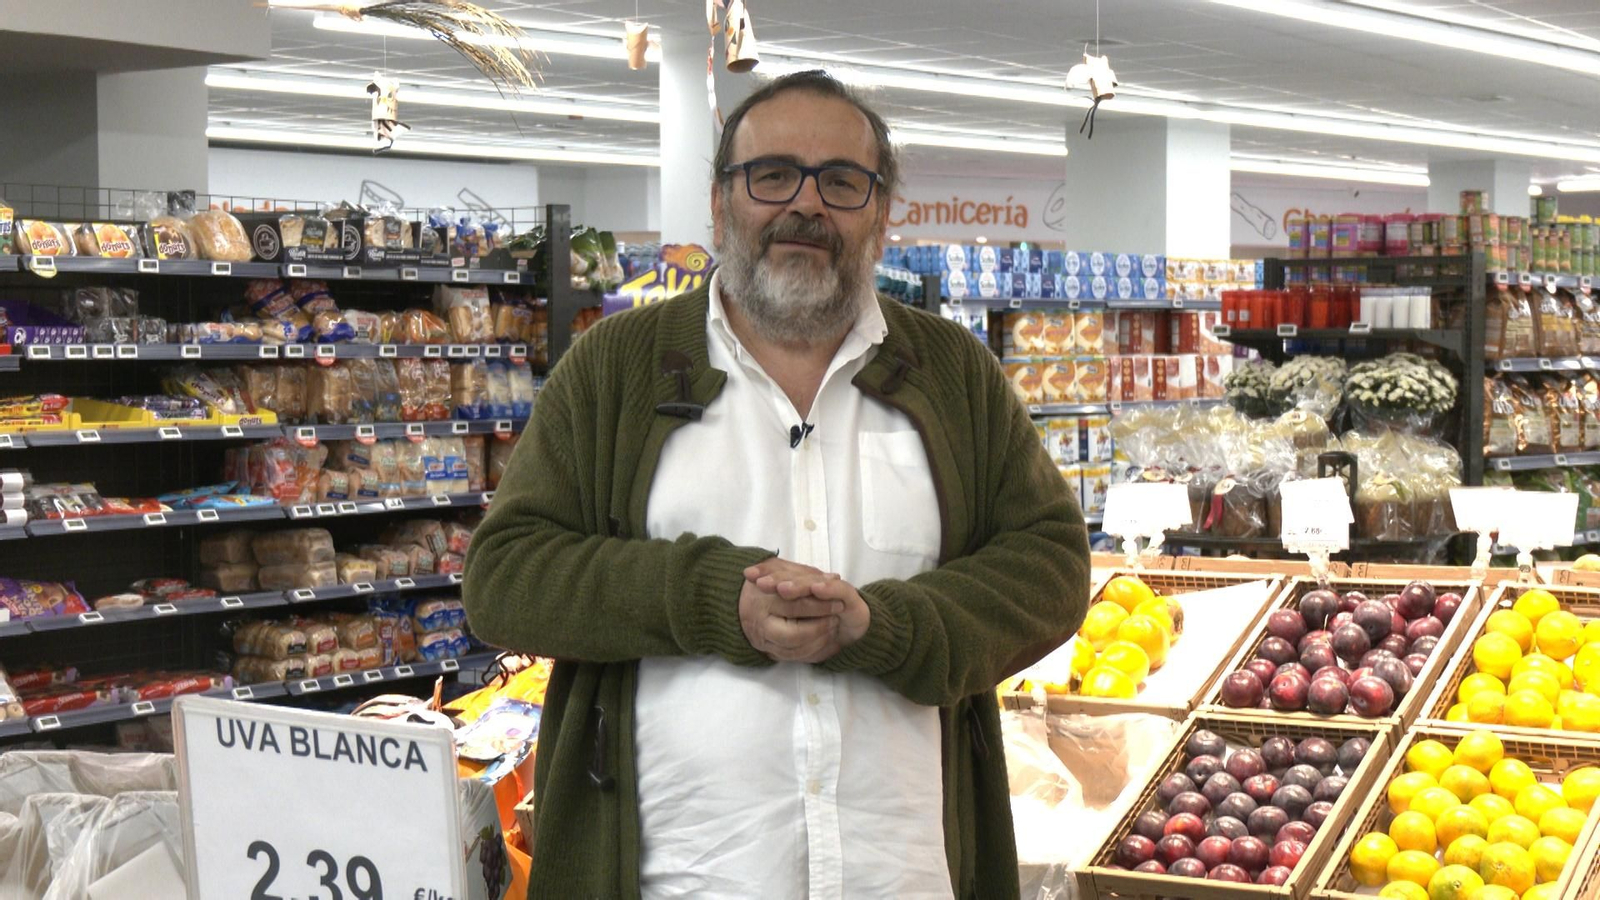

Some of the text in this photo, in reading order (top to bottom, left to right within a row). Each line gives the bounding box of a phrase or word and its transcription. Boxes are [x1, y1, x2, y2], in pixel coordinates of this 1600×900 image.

[886, 195, 1028, 228] Carnicería
[101, 240, 131, 252] donuts
[215, 716, 428, 773] UVA BLANCA
